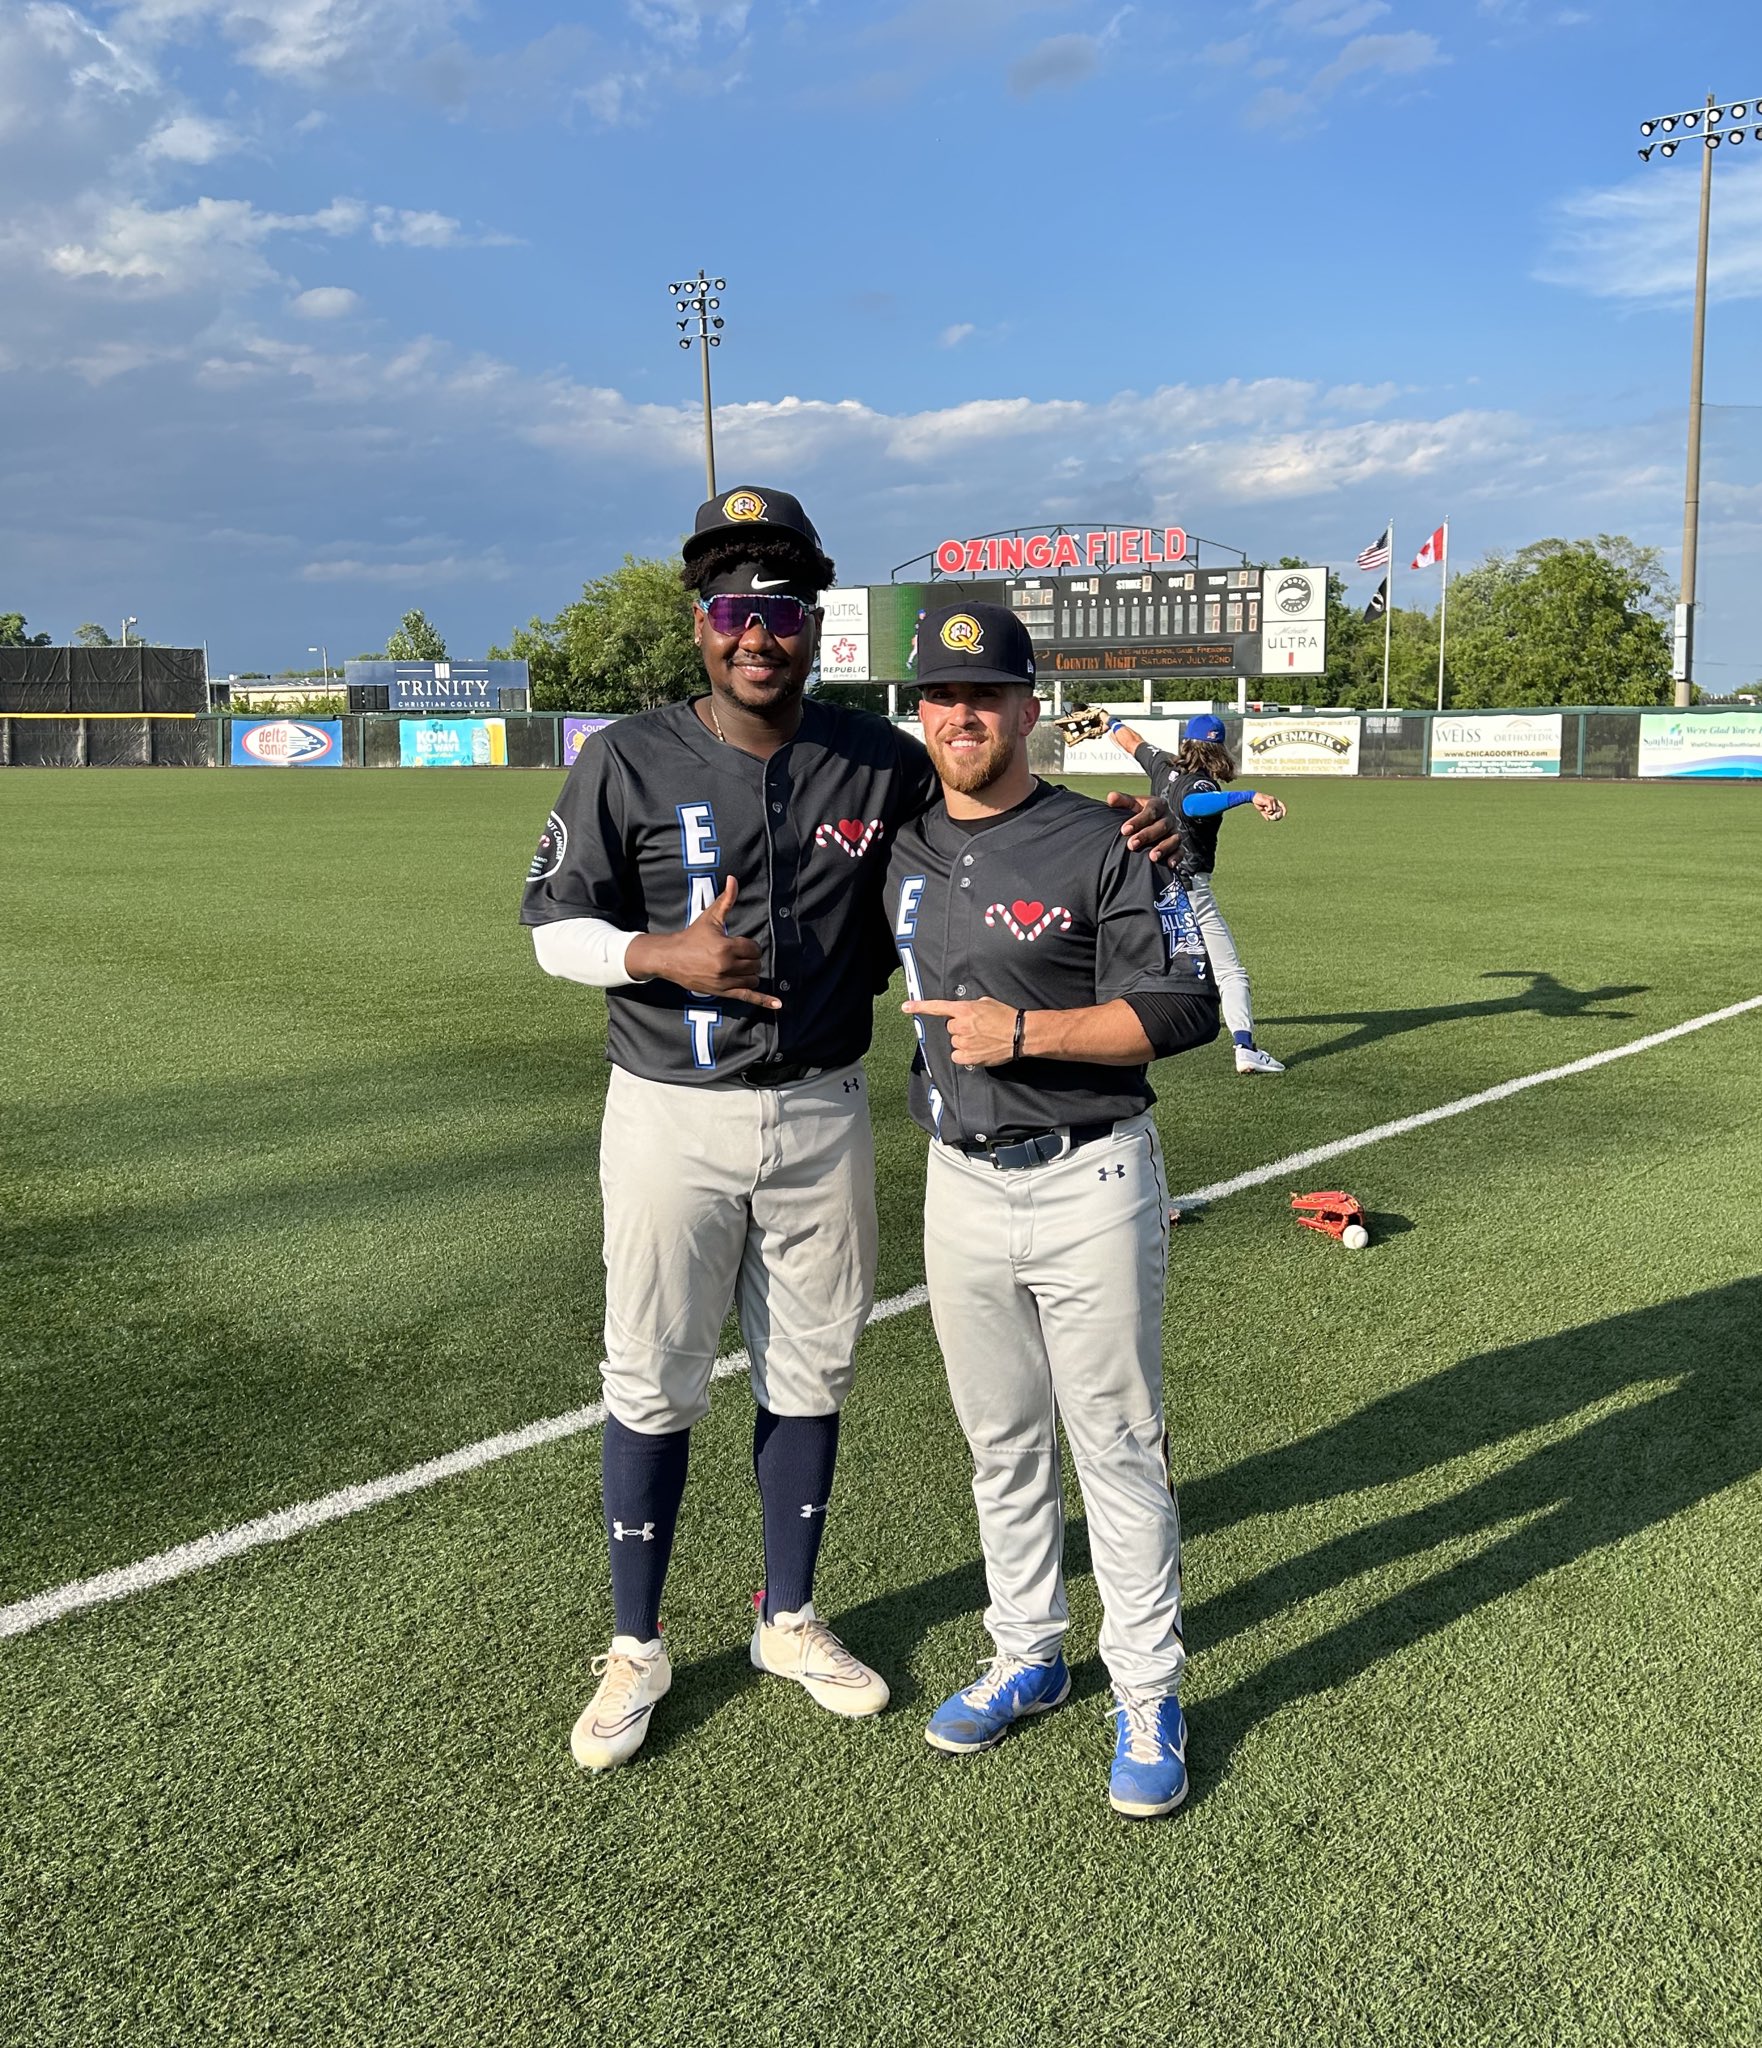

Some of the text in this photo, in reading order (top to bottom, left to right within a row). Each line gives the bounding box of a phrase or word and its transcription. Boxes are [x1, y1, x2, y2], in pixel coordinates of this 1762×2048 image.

[1086, 527, 1187, 566] FIELD
[1077, 599, 1082, 607] 2
[1148, 596, 1153, 604] 7
[1281, 600, 1307, 612] ISLAND
[940, 613, 984, 654] Q
[1268, 636, 1318, 649] ULTRA
[397, 680, 490, 696] TRINITY
[259, 728, 288, 743] delta
[416, 730, 459, 744] KONA
[1435, 728, 1481, 743] WEISS
[1709, 726, 1730, 734] Glad
[1265, 731, 1334, 748] GLENMARK
[259, 743, 288, 756] sonic
[1066, 752, 1087, 760] OLD
